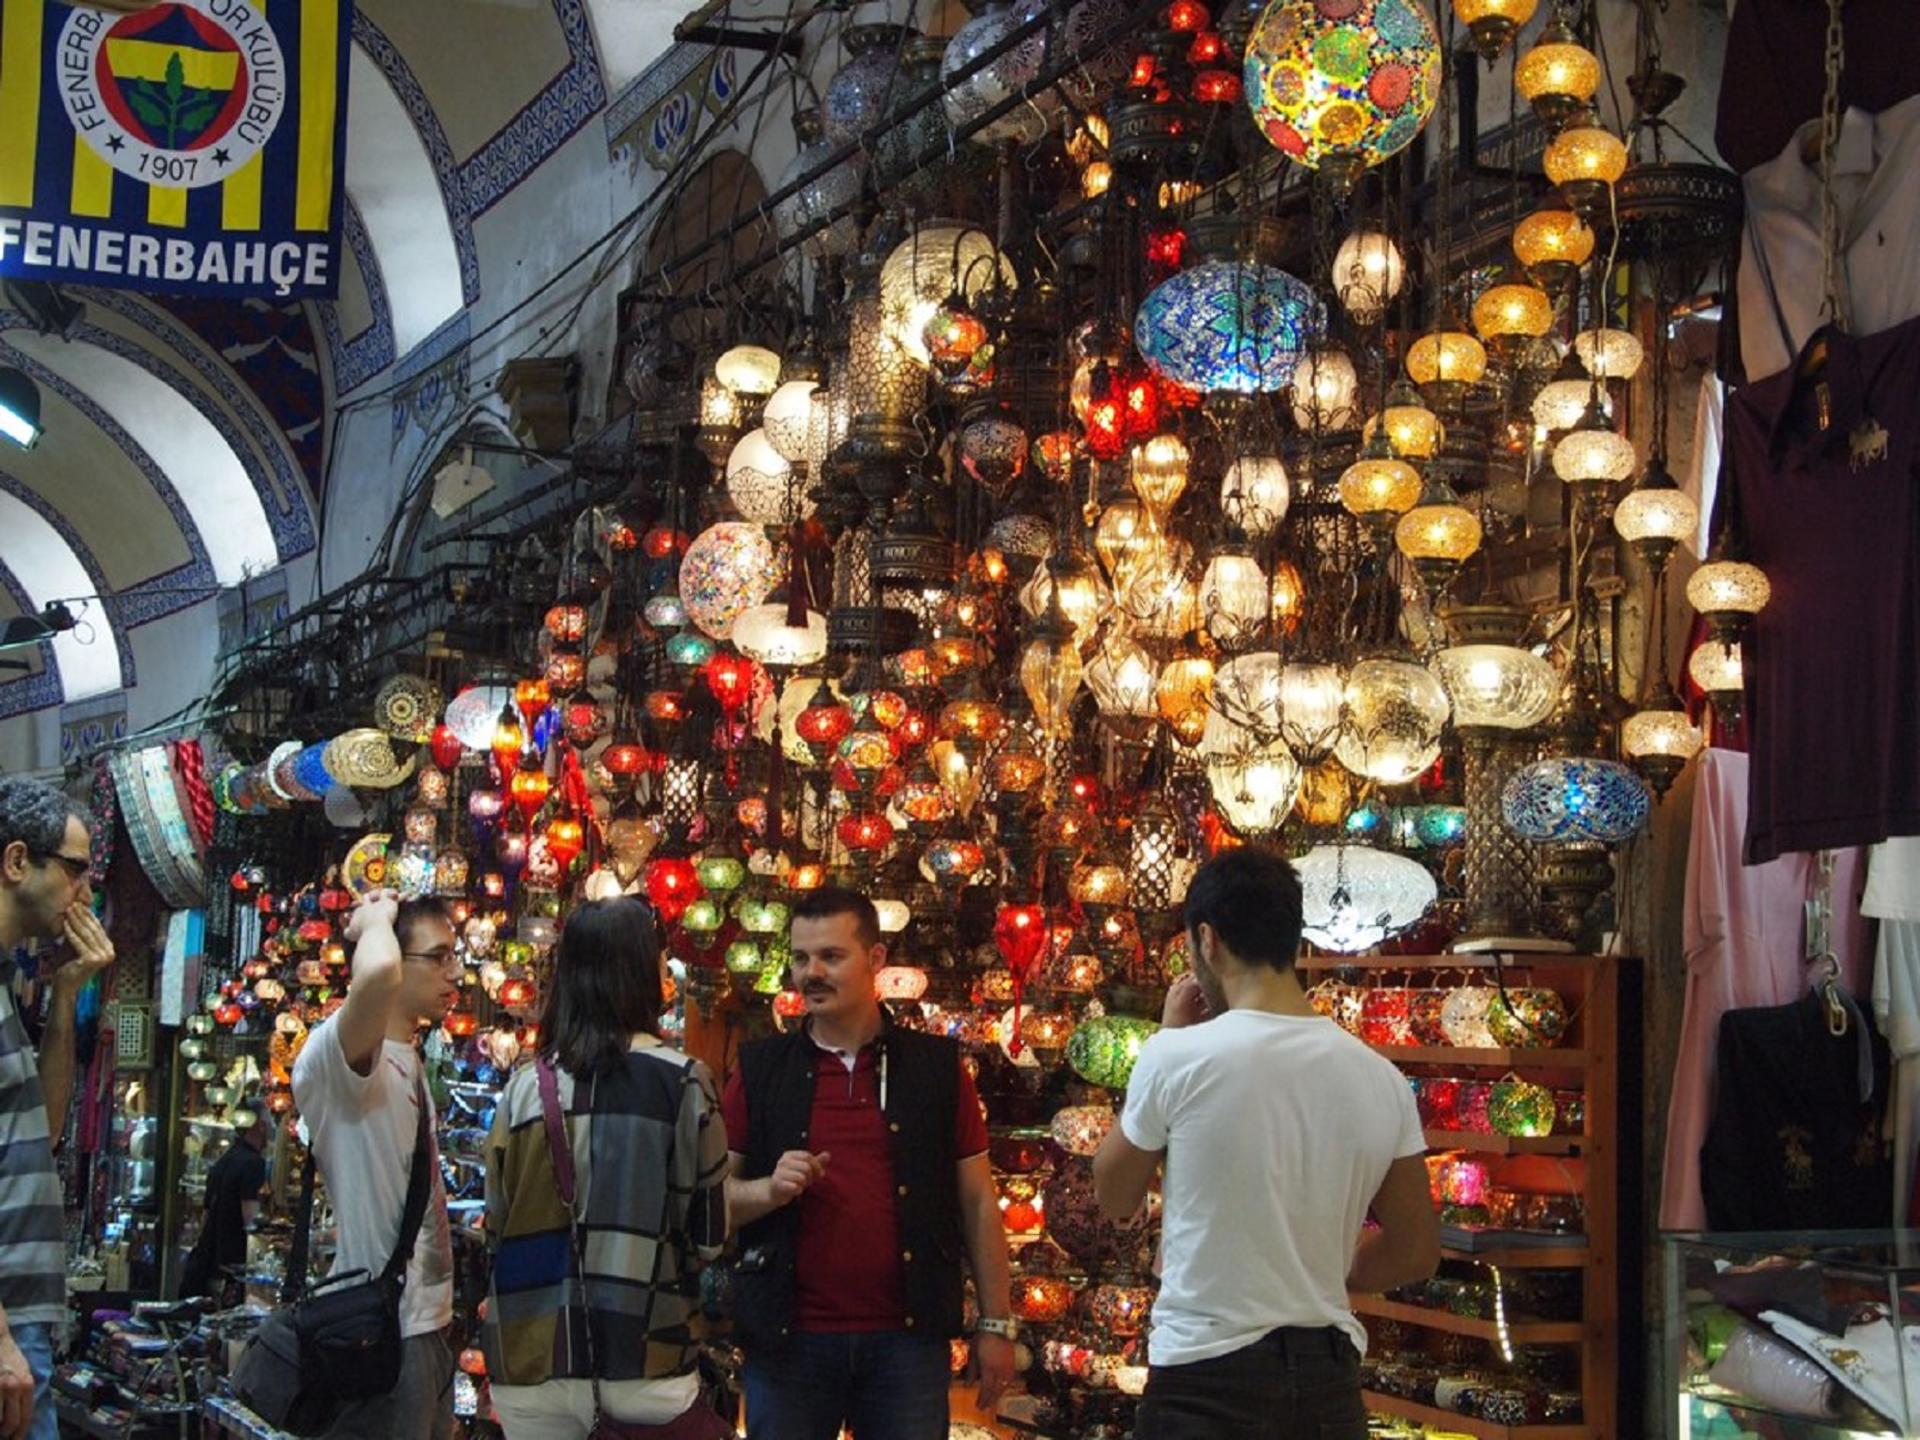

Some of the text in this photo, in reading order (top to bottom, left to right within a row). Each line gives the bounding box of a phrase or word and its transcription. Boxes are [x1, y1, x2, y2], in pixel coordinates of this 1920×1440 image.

[209, 0, 251, 31] OR
[236, 26, 283, 144] KULÜBÜ
[138, 153, 198, 181] 1907
[0, 217, 329, 296] FENERBAHÇE
